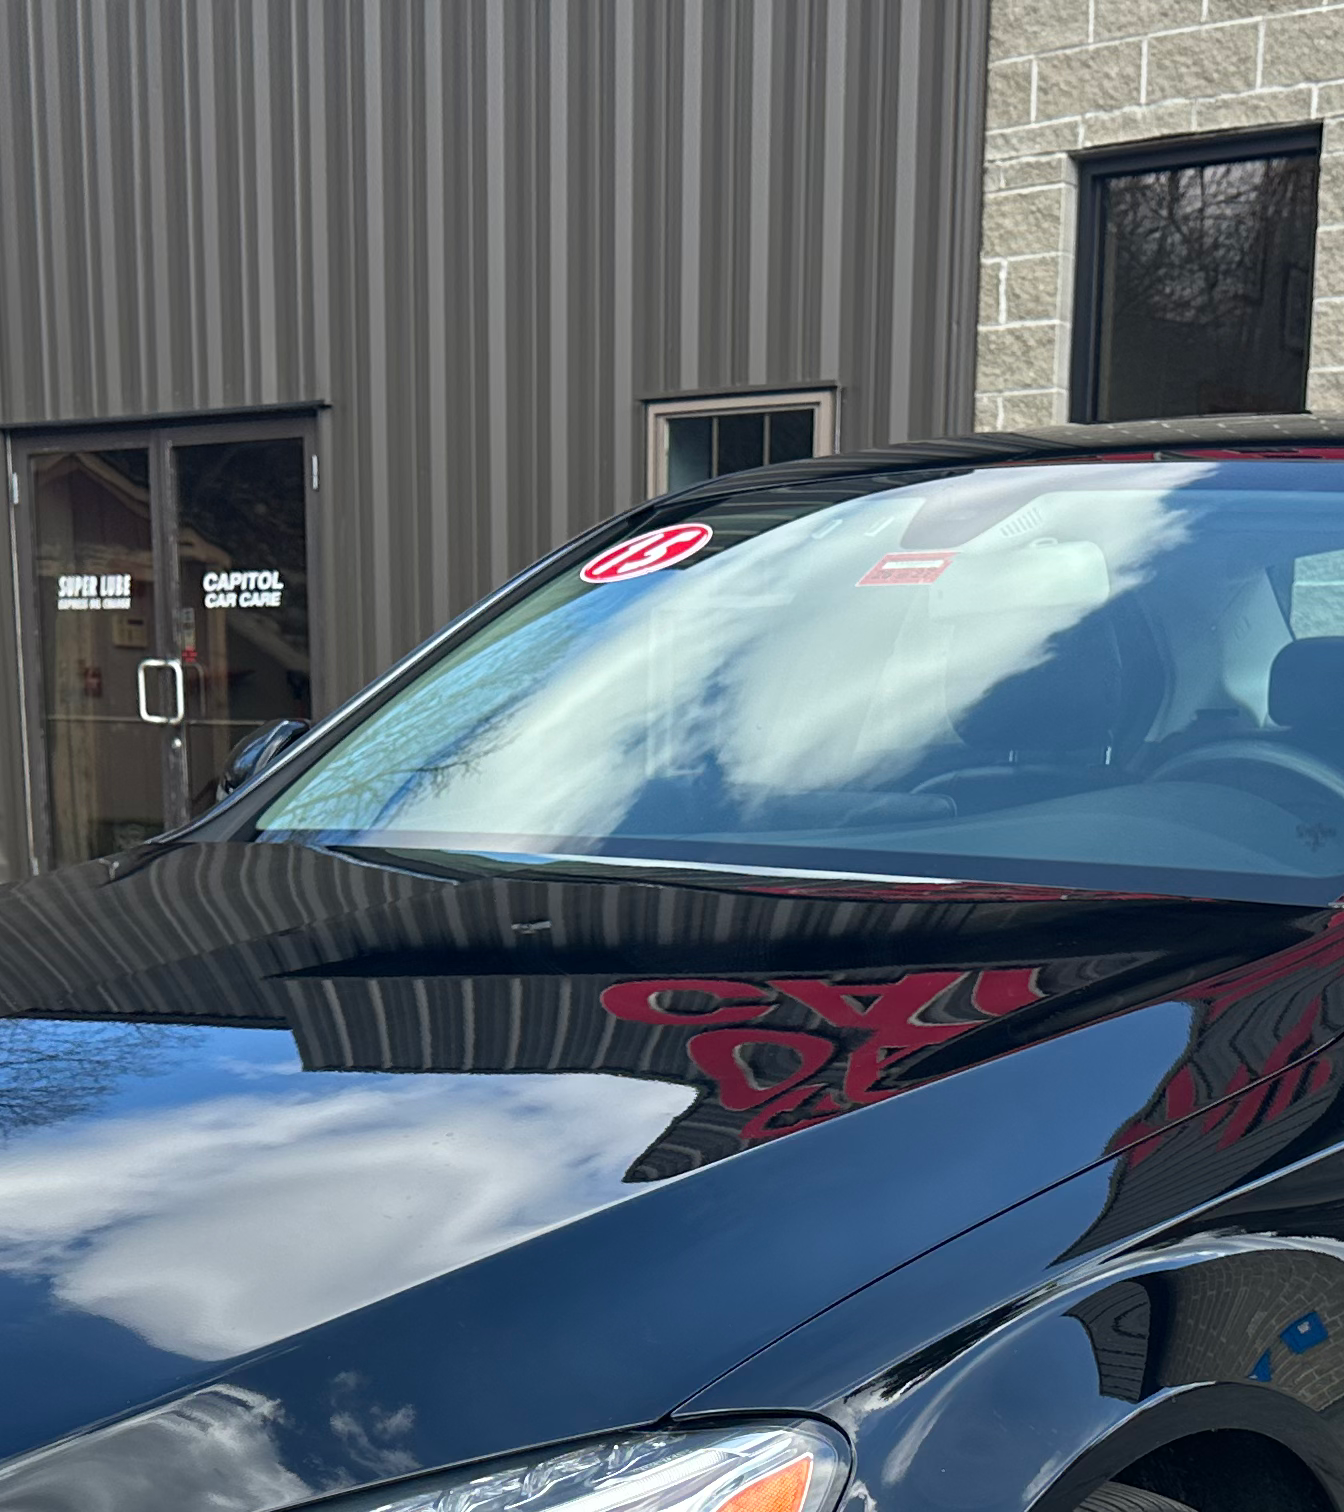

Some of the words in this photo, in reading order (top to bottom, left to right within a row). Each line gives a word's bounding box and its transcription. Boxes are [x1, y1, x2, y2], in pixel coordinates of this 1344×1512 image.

[58, 575, 98, 597] SUPER
[99, 574, 132, 597] LUBE
[202, 570, 285, 592] CAPITOL
[204, 592, 237, 609] CAR
[238, 591, 282, 608] CARE
